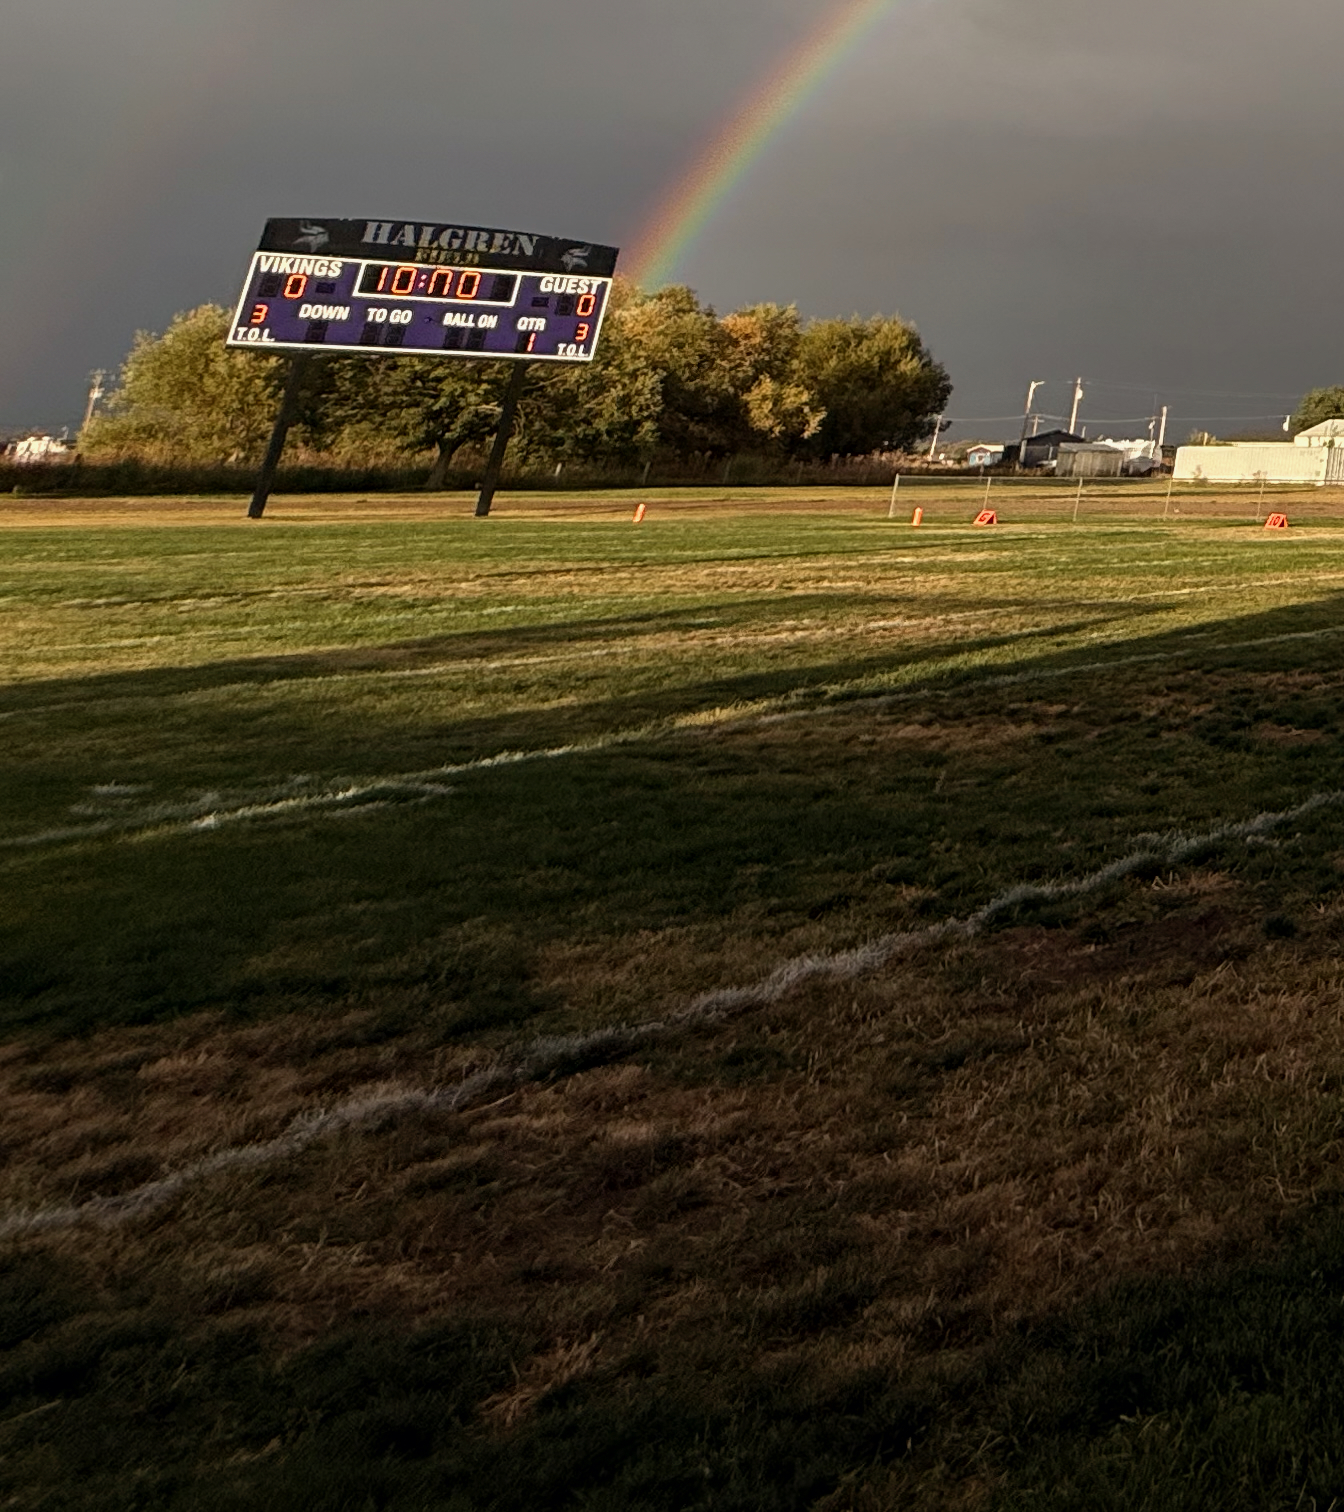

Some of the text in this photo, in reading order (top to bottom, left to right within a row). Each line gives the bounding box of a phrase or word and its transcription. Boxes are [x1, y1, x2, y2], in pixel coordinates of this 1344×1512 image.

[361, 221, 540, 256] HALGREN
[260, 255, 343, 277] VIKINGS
[283, 274, 308, 299] 0
[540, 276, 602, 295] GUEST
[250, 304, 269, 325] 3
[298, 303, 351, 321] DOWN
[576, 294, 596, 316] 0
[367, 307, 413, 325] TO GO
[443, 312, 499, 329] BALL ON
[516, 316, 547, 332] QTR
[235, 326, 276, 342] T.O.L.
[575, 322, 590, 341] 3
[526, 332, 537, 352] 1
[557, 342, 589, 357] T.O.L.
[1268, 515, 1281, 526] 10
